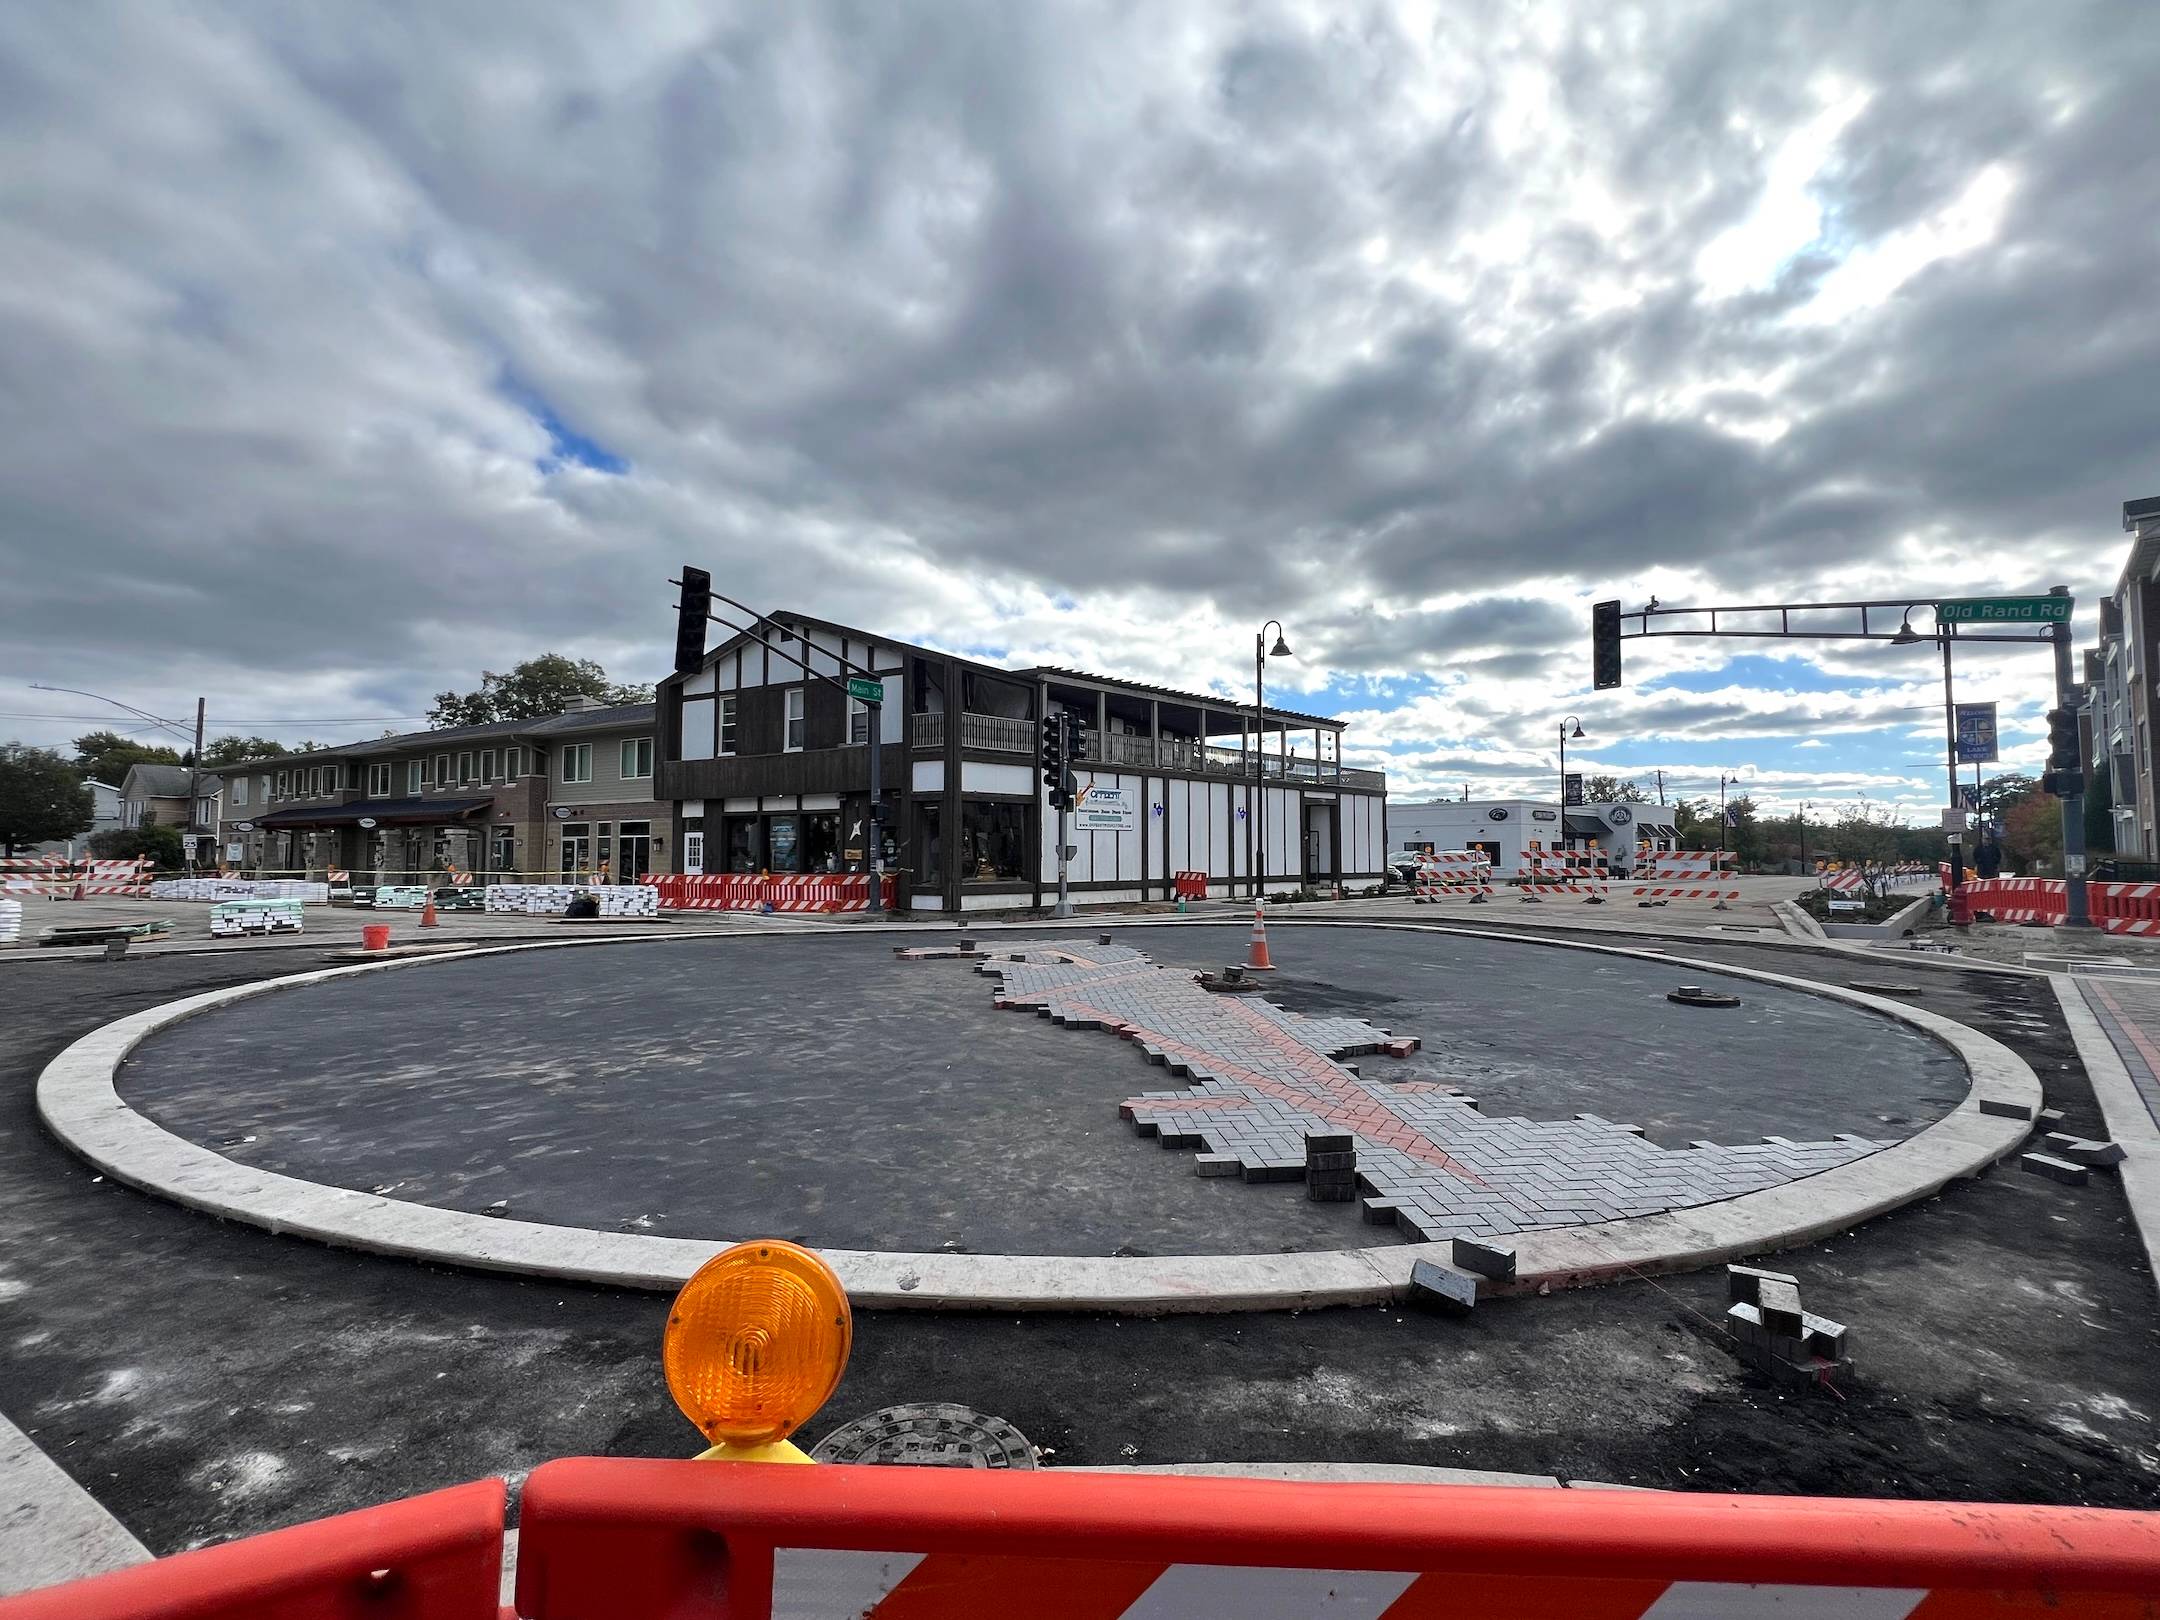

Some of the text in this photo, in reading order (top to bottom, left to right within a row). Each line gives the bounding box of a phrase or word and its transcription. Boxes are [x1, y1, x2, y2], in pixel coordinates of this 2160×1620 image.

[1943, 603, 2065, 618] Old Rand Rd
[851, 683, 882, 697] Main St
